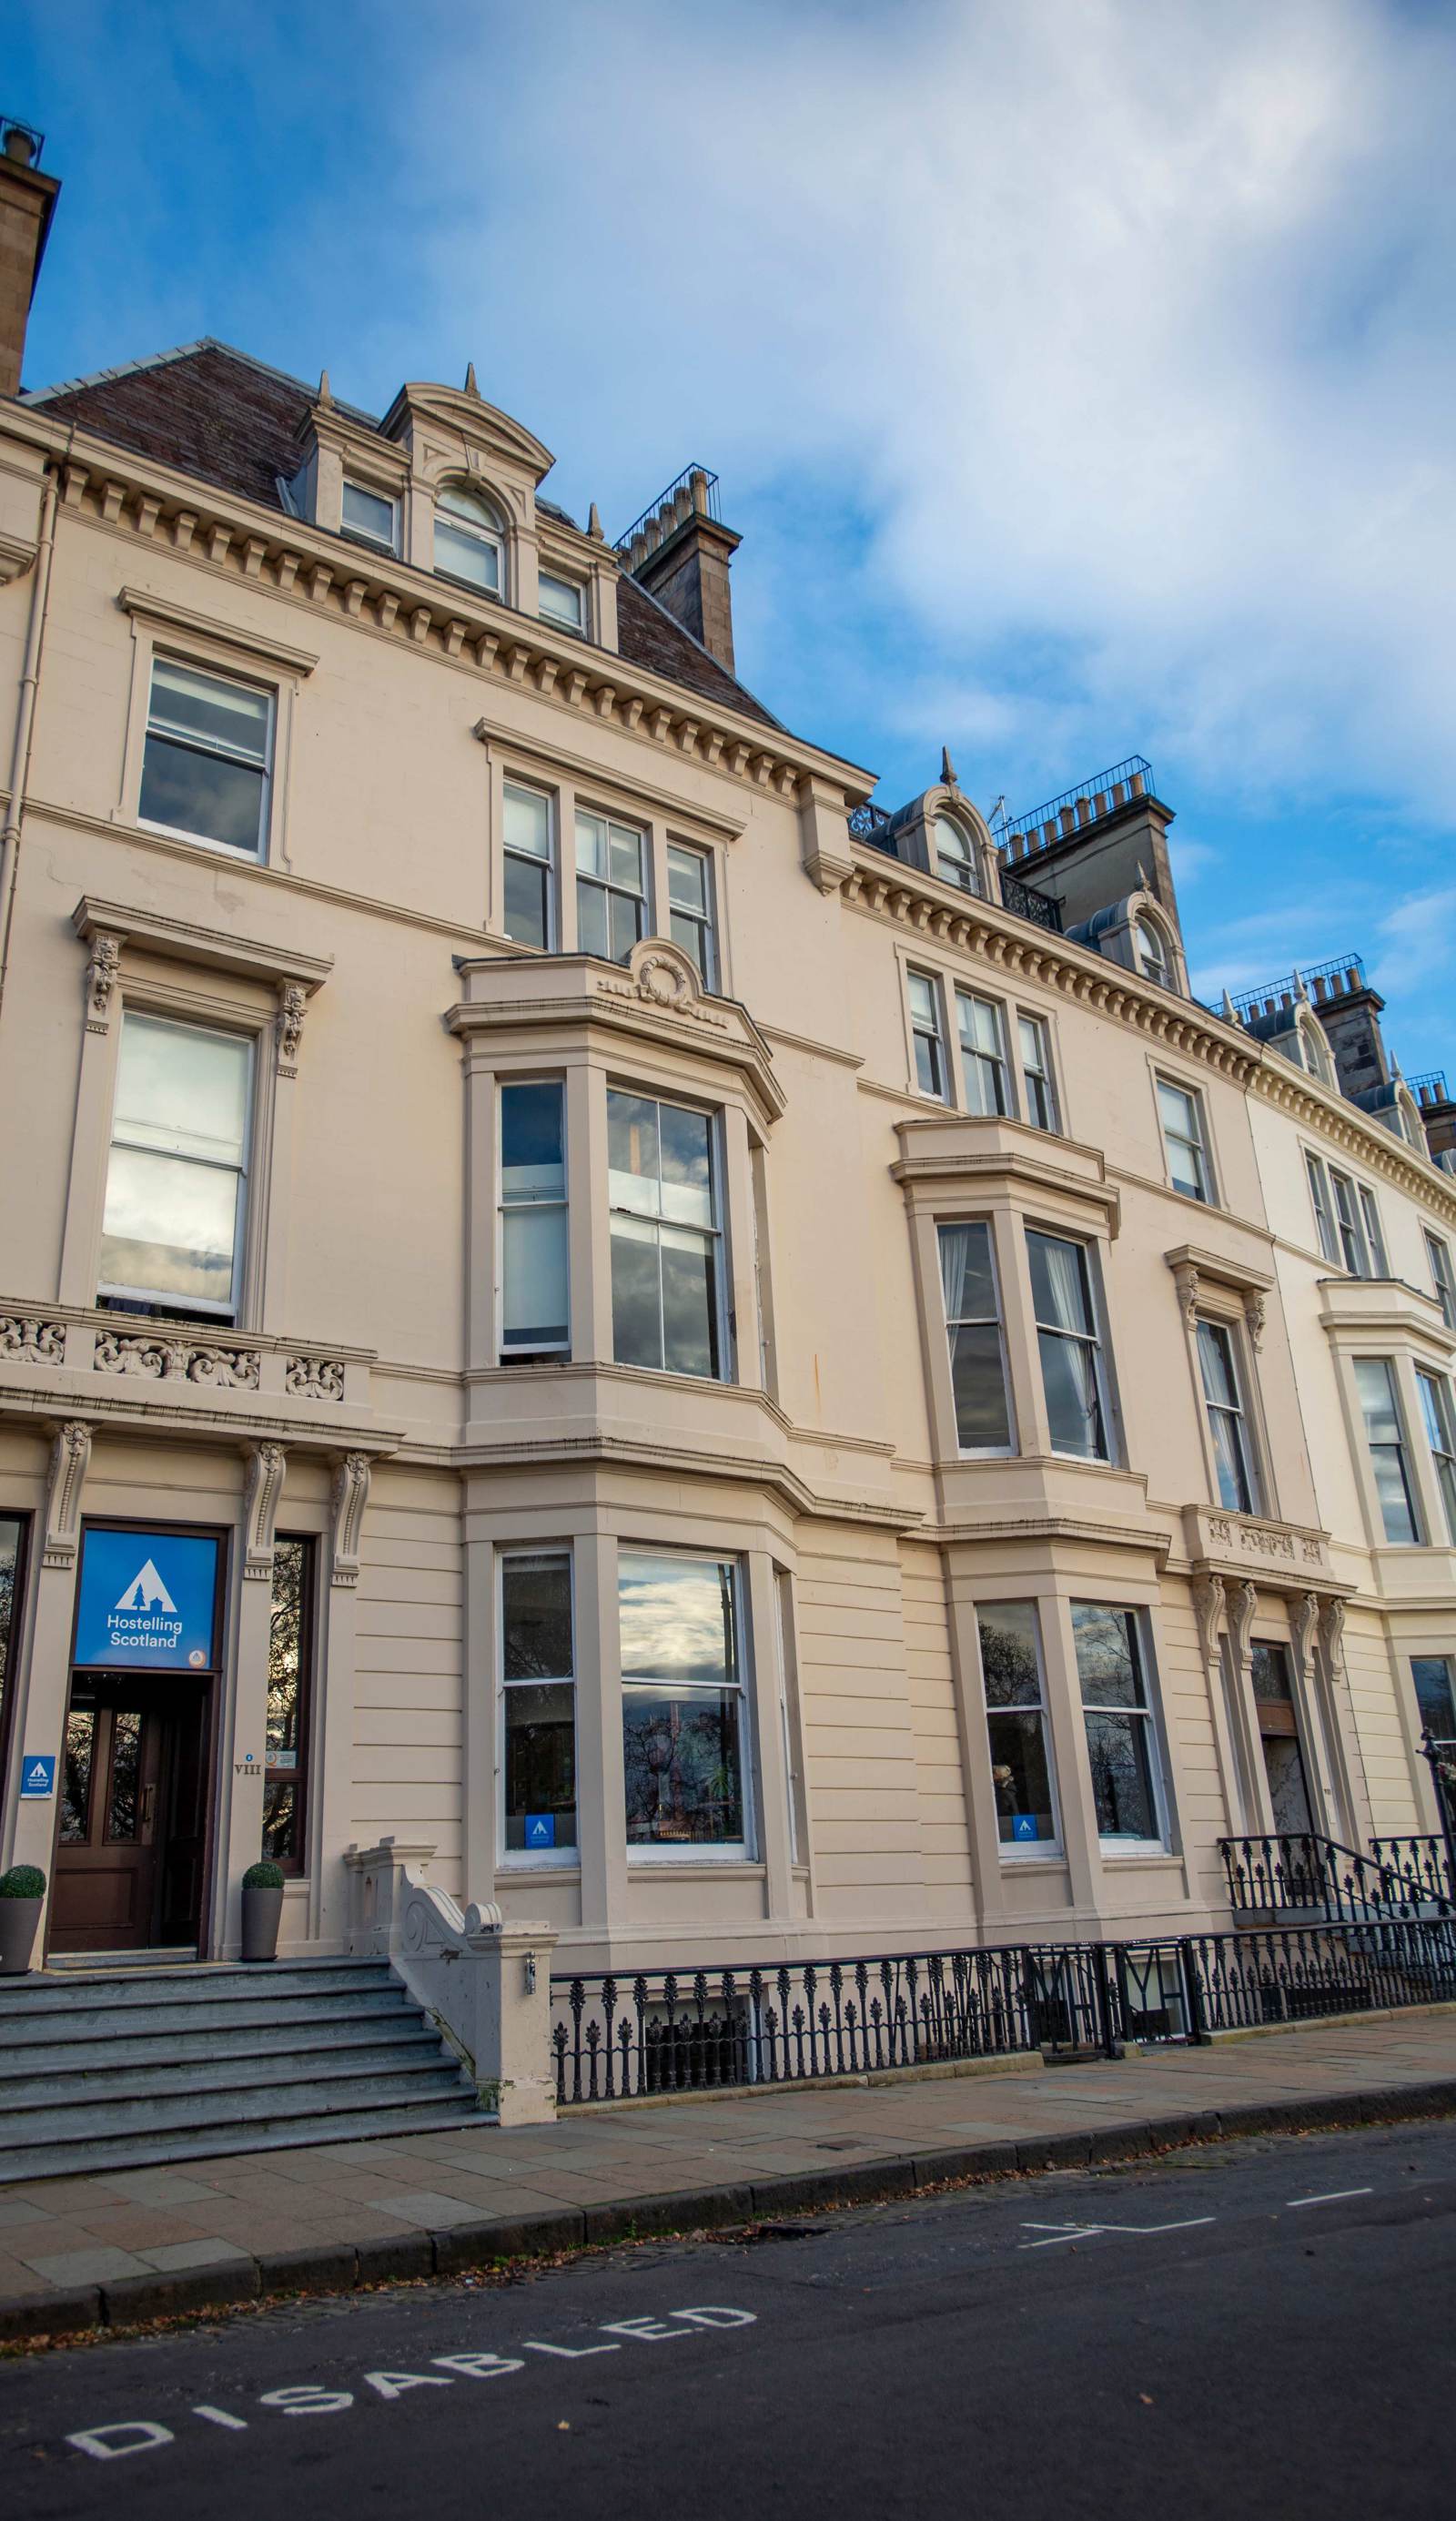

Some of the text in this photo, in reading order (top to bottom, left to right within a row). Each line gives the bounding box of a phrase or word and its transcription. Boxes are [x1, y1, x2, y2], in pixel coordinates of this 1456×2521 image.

[107, 1615, 182, 1635] Hostelling
[110, 1632, 177, 1648] Scotland
[234, 1765, 262, 1775] VIII
[66, 2306, 758, 2458] DISABLED
